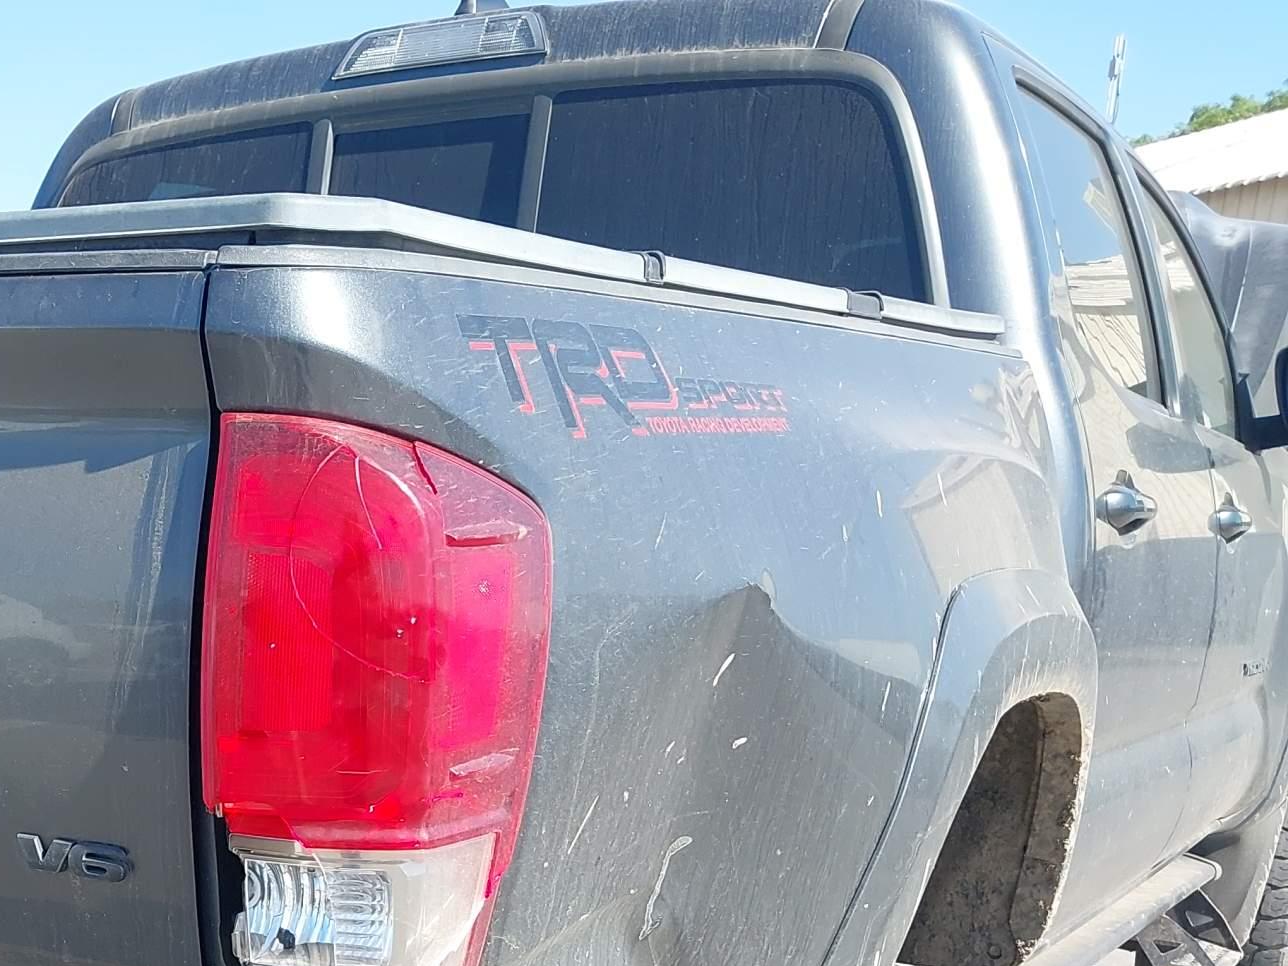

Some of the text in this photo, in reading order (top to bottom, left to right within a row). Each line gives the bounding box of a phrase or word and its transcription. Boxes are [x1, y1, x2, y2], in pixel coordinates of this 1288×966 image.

[455, 313, 680, 440] TRD
[646, 415, 689, 434] TOYOTA
[16, 831, 133, 883] V6
